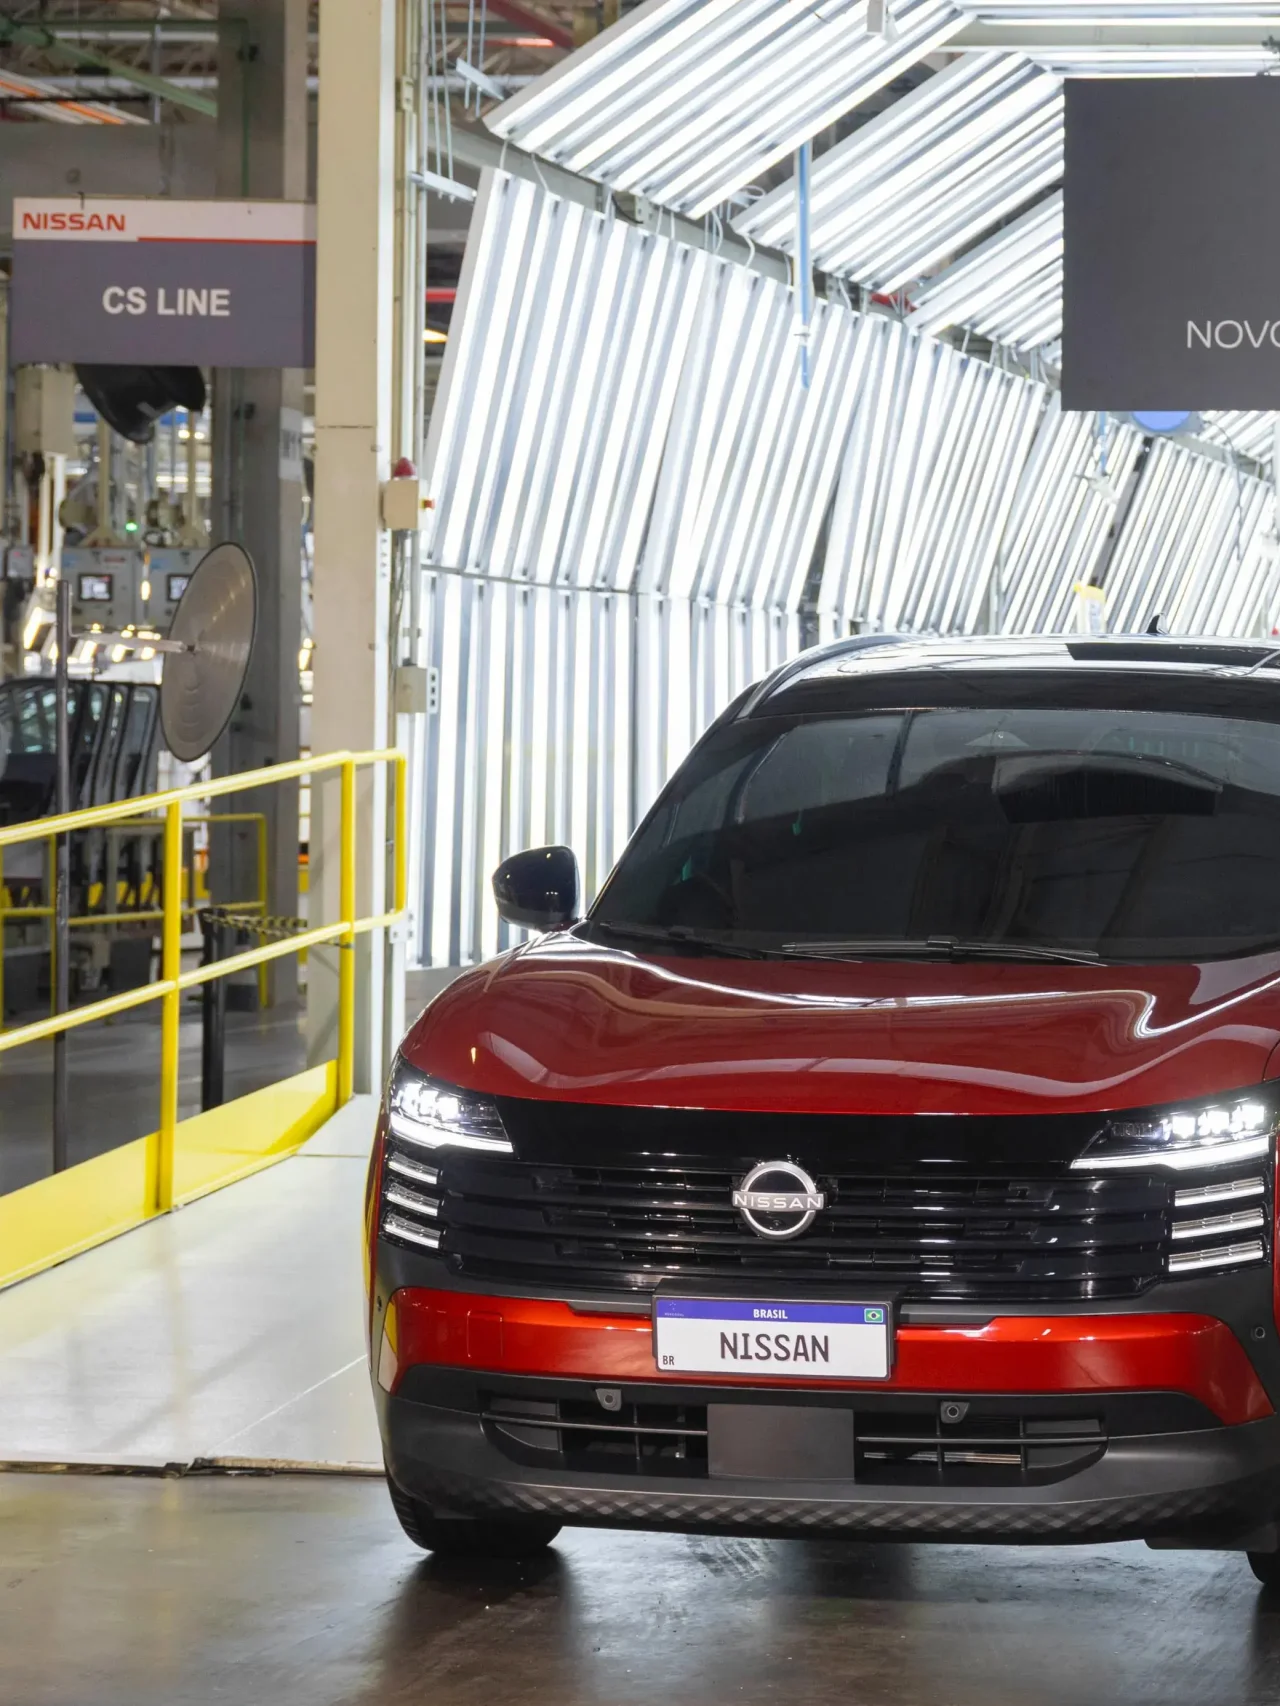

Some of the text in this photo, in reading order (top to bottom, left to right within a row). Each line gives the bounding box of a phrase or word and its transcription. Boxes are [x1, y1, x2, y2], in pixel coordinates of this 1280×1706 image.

[22, 212, 126, 232] NISSAN
[102, 286, 231, 316] CS LINE
[734, 1193, 821, 1209] NISSAN
[753, 1308, 788, 1320] BRASIL
[720, 1331, 830, 1363] NISSAN
[662, 1355, 675, 1366] BR
